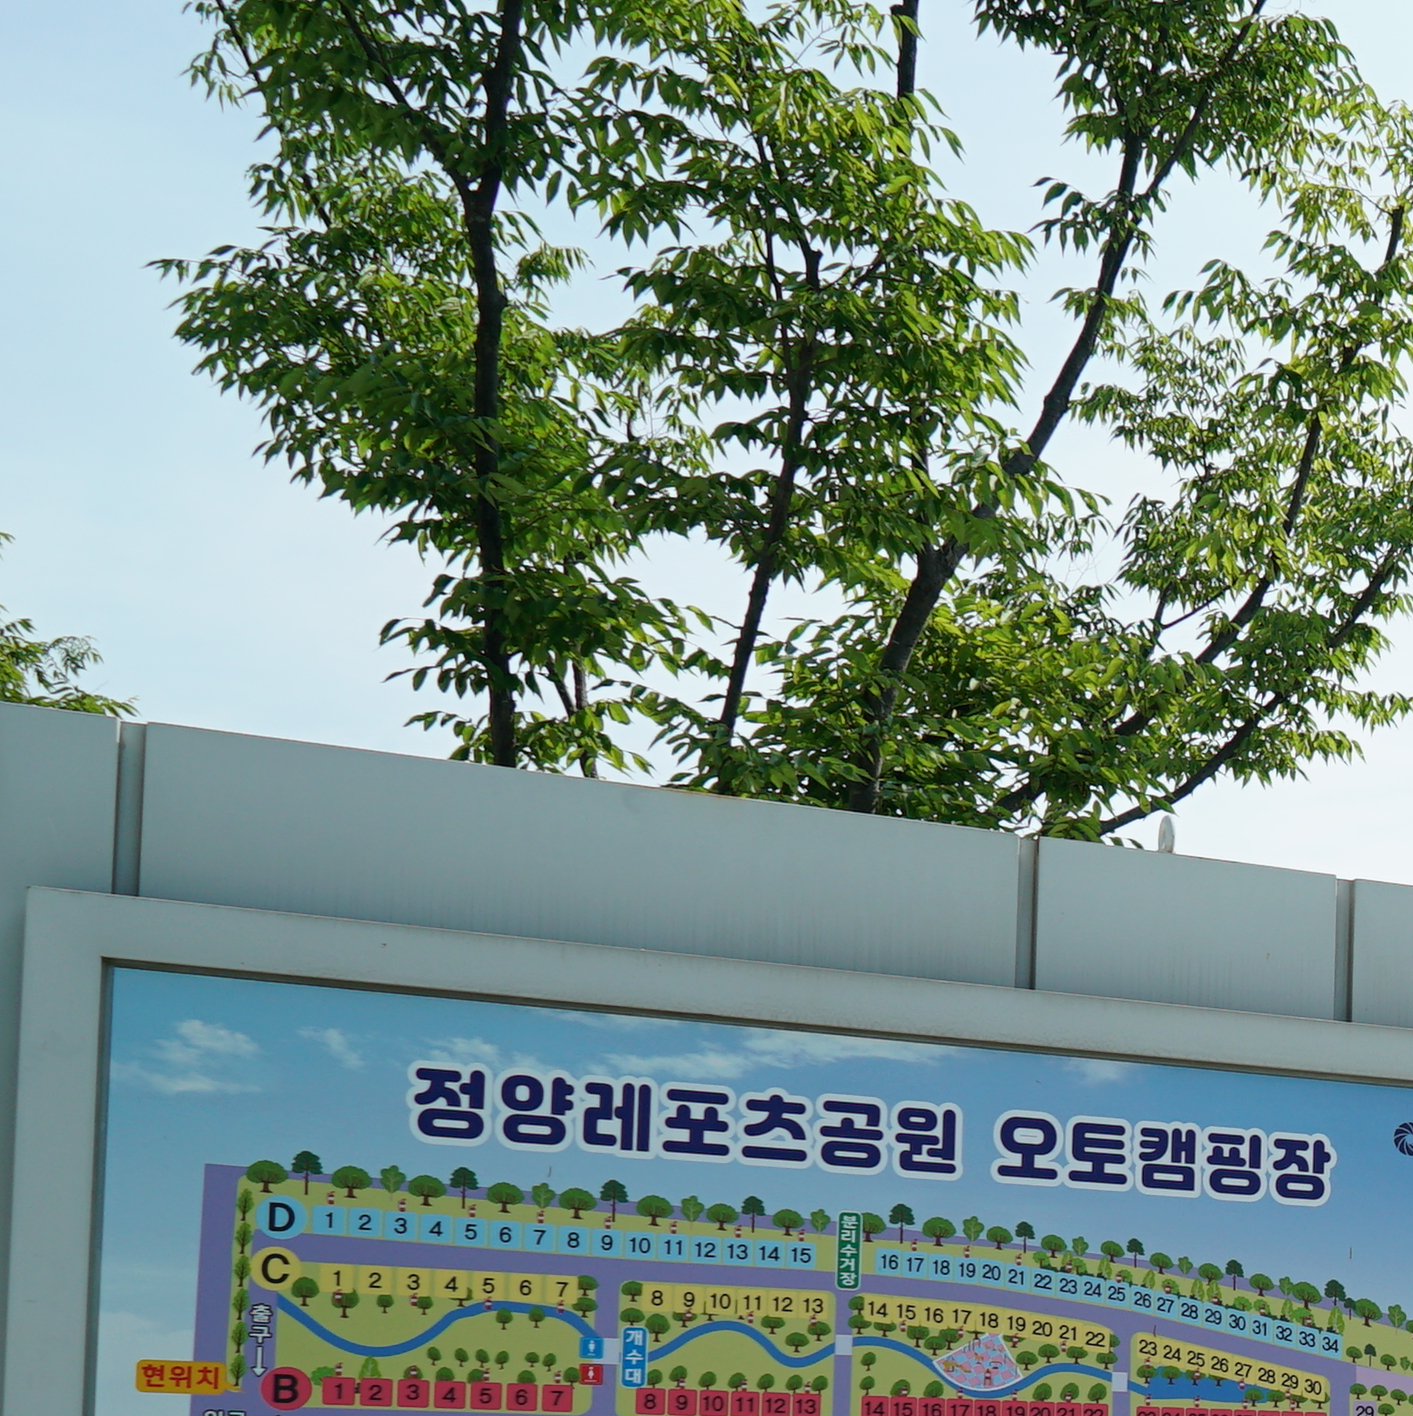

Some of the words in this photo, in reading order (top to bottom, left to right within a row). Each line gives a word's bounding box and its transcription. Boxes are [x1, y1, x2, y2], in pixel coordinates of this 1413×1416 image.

[414, 1066, 958, 1175] 정양레포츠공원
[995, 1114, 1332, 1200] 오토캠핑장
[268, 1201, 296, 1232] D
[325, 1212, 333, 1229] 1
[358, 1214, 372, 1231] 2
[393, 1217, 408, 1235] 3
[428, 1220, 443, 1237] 4
[464, 1223, 478, 1240] 5
[499, 1226, 512, 1243] 6
[533, 1229, 547, 1245] 7
[567, 1231, 580, 1249] 8
[601, 1234, 613, 1251] 9
[629, 1237, 651, 1254] 10
[664, 1239, 682, 1256] 11
[695, 1242, 716, 1258] 12
[727, 1243, 748, 1260] 13
[759, 1245, 780, 1262] 14
[791, 1247, 812, 1264] 15
[838, 1215, 858, 1287] 분리수거장
[261, 1253, 290, 1284] C
[333, 1270, 341, 1287] 1
[368, 1272, 382, 1289] 2
[407, 1273, 420, 1291] 3
[444, 1276, 458, 1292] 4
[482, 1277, 495, 1294] 5
[519, 1279, 532, 1296] 6
[556, 1281, 569, 1297] 7
[651, 1290, 664, 1307] 8
[683, 1291, 695, 1308] 9
[710, 1293, 731, 1310] 10
[743, 1295, 761, 1311] 11
[773, 1296, 793, 1313] 12
[804, 1298, 824, 1314] 13
[249, 1303, 273, 1344] 출구
[141, 1363, 220, 1390] 현위치
[624, 1329, 646, 1385] 개수대
[271, 1373, 300, 1405] B
[334, 1382, 343, 1400] 1
[367, 1384, 384, 1402] 2
[405, 1383, 421, 1401] 3
[441, 1386, 458, 1404] 4
[478, 1387, 493, 1405] 5
[514, 1388, 529, 1406] 6
[549, 1390, 565, 1407] 7
